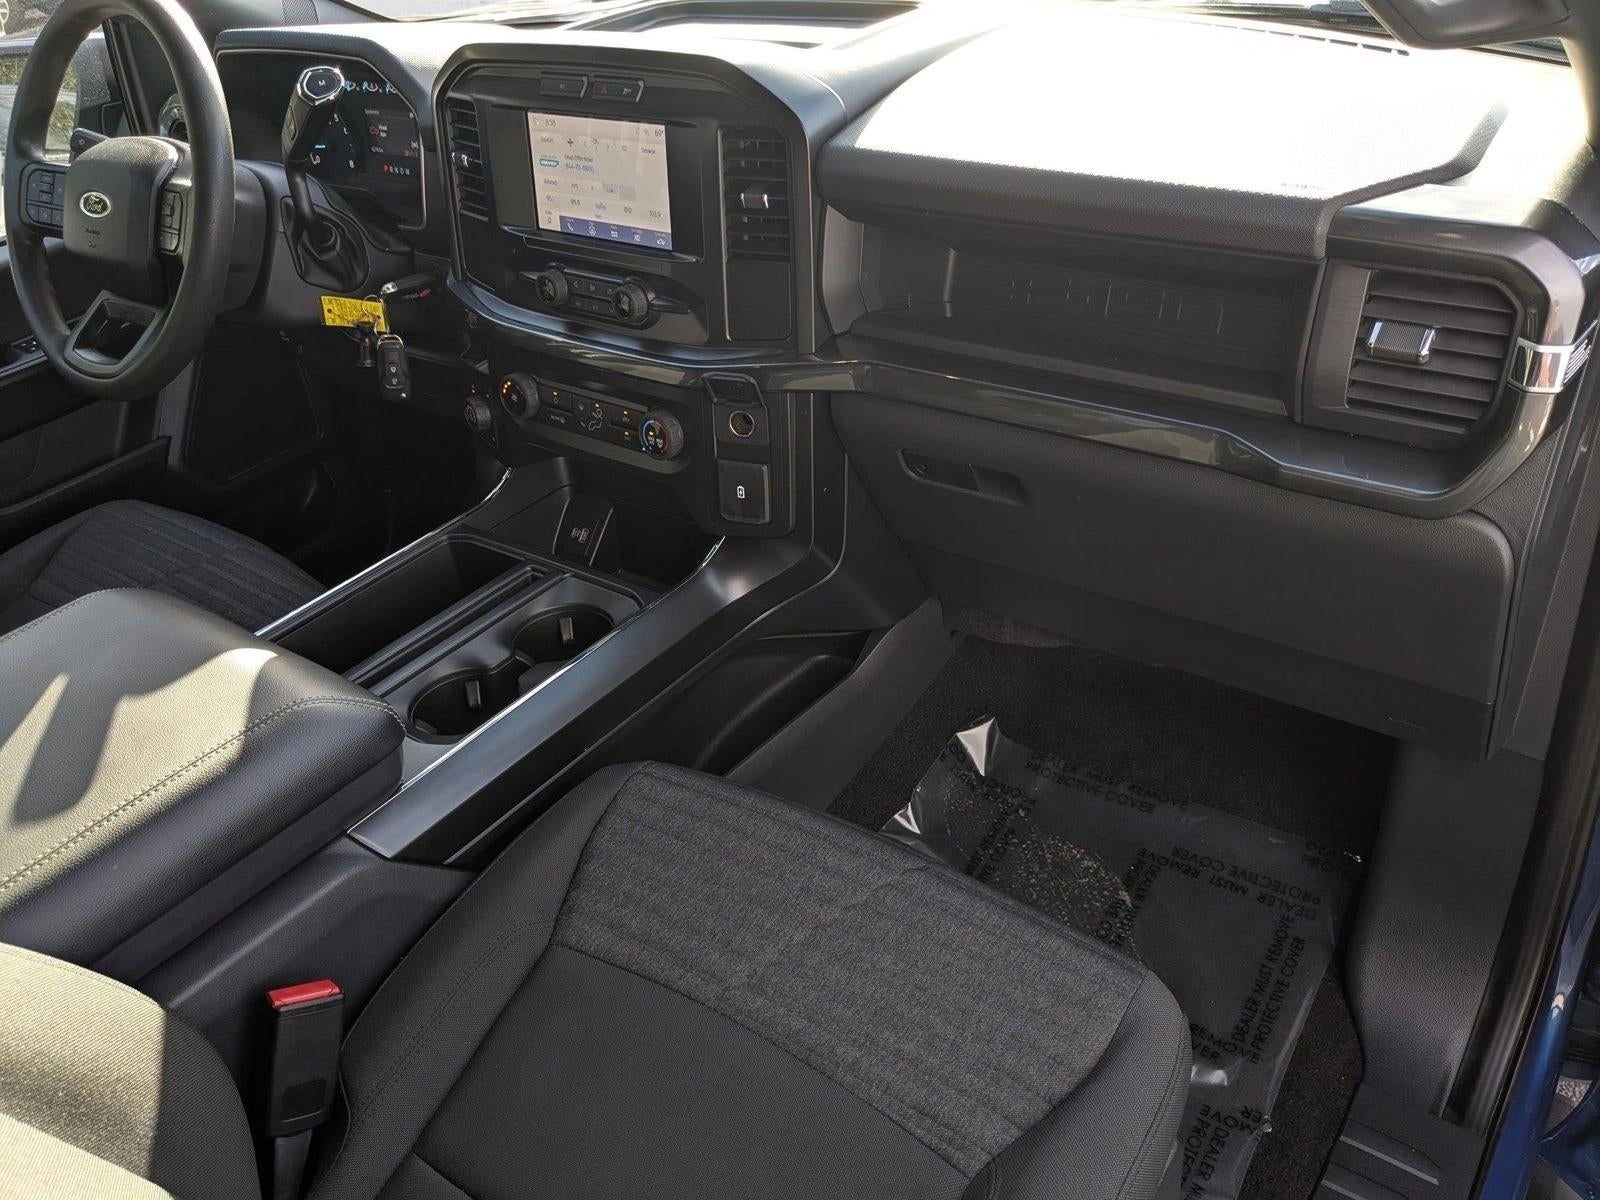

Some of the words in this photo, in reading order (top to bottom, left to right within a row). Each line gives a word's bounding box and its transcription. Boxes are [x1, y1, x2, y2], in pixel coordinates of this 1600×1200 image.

[1171, 846, 1225, 873] COVER
[1208, 874, 1250, 897] MUST
[1229, 864, 1321, 906] PROTECTIVE
[1257, 891, 1317, 921] DEALER
[1263, 913, 1296, 965] REMOVE
[1250, 977, 1291, 1052] PROTECTIVE
[1280, 935, 1306, 979] COVER
[1252, 963, 1275, 997] MUST
[1232, 997, 1262, 1044] DEALER
[1199, 1126, 1231, 1182] DEALER
